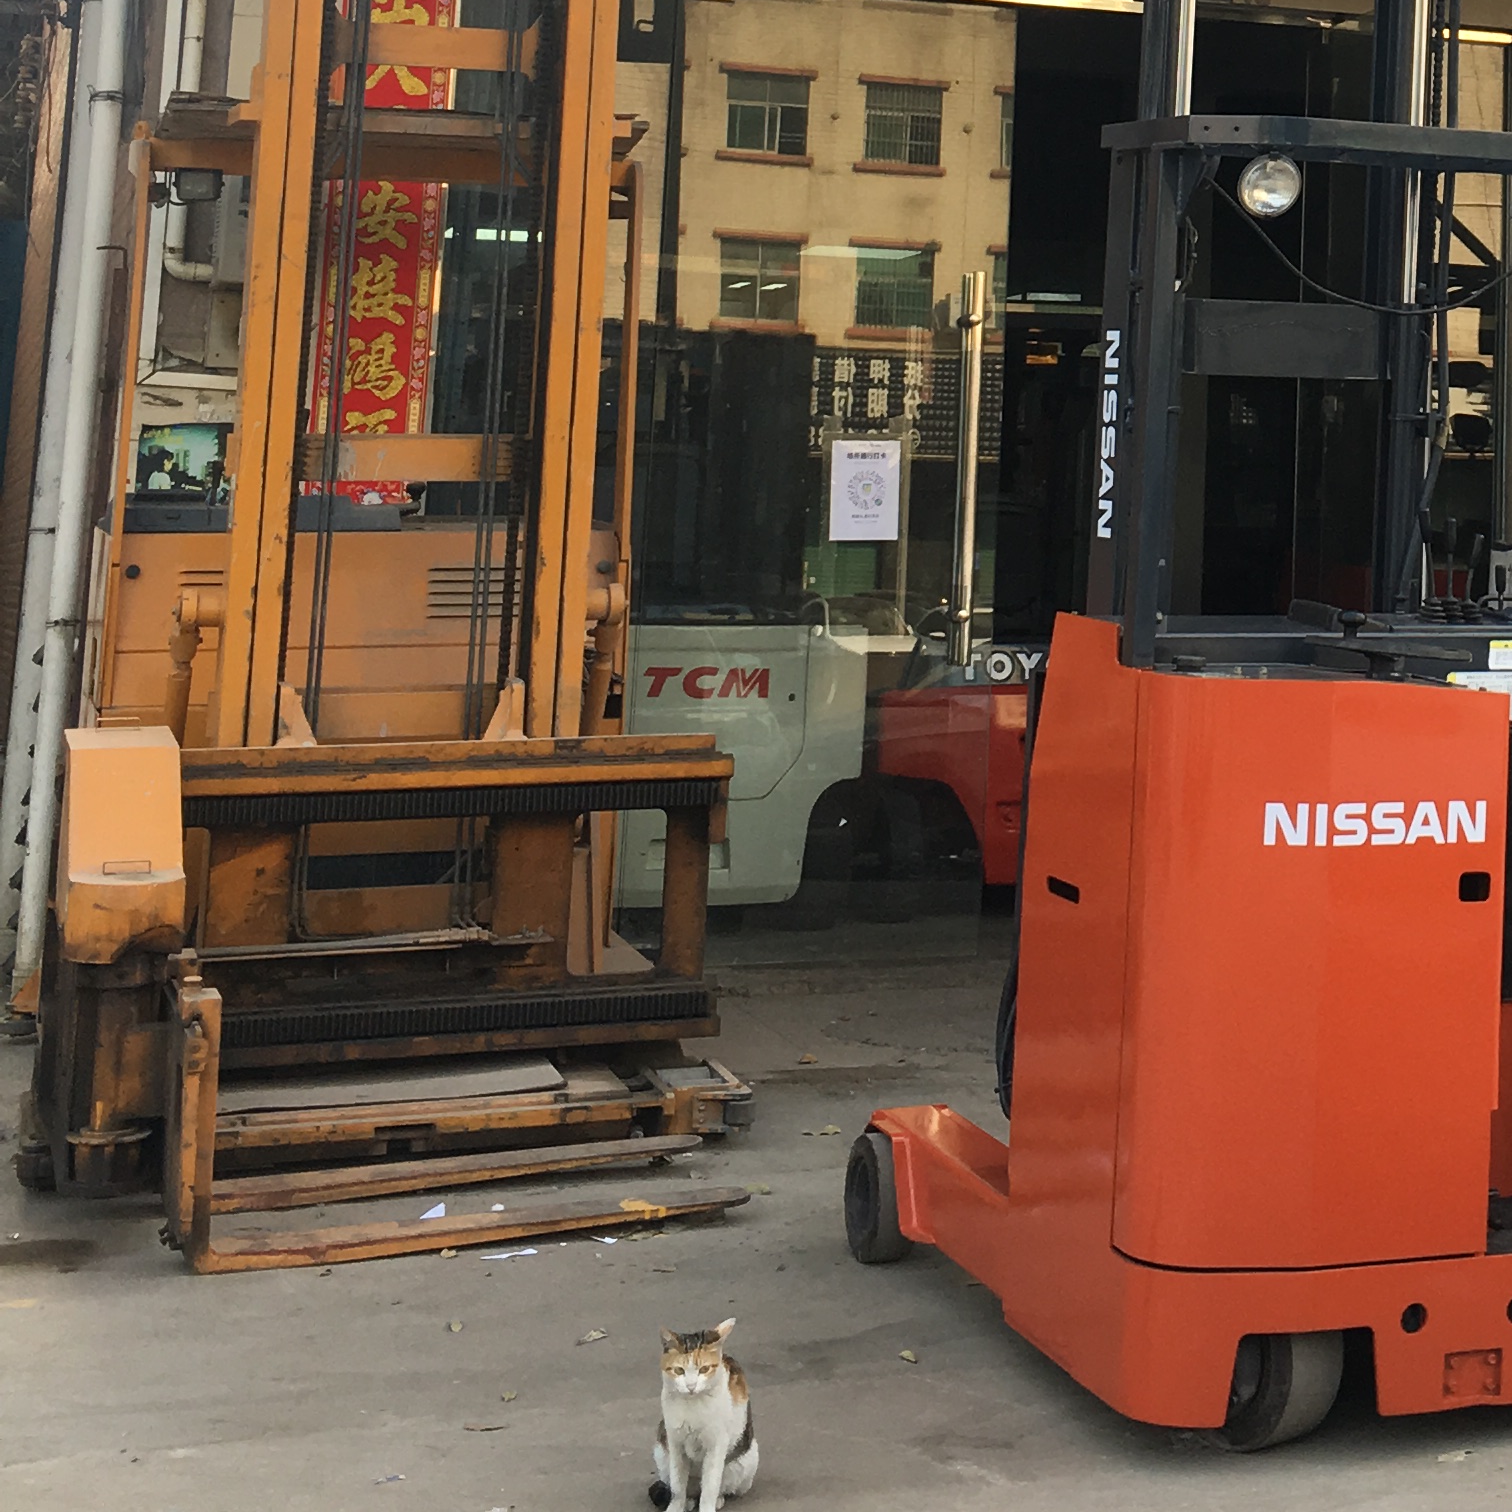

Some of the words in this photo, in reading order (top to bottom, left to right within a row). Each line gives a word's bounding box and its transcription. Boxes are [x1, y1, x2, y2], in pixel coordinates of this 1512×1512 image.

[1096, 329, 1121, 539] NISSAN
[643, 665, 771, 699] TCM
[965, 652, 1050, 681] TOY
[1263, 800, 1487, 846] NISSAN
